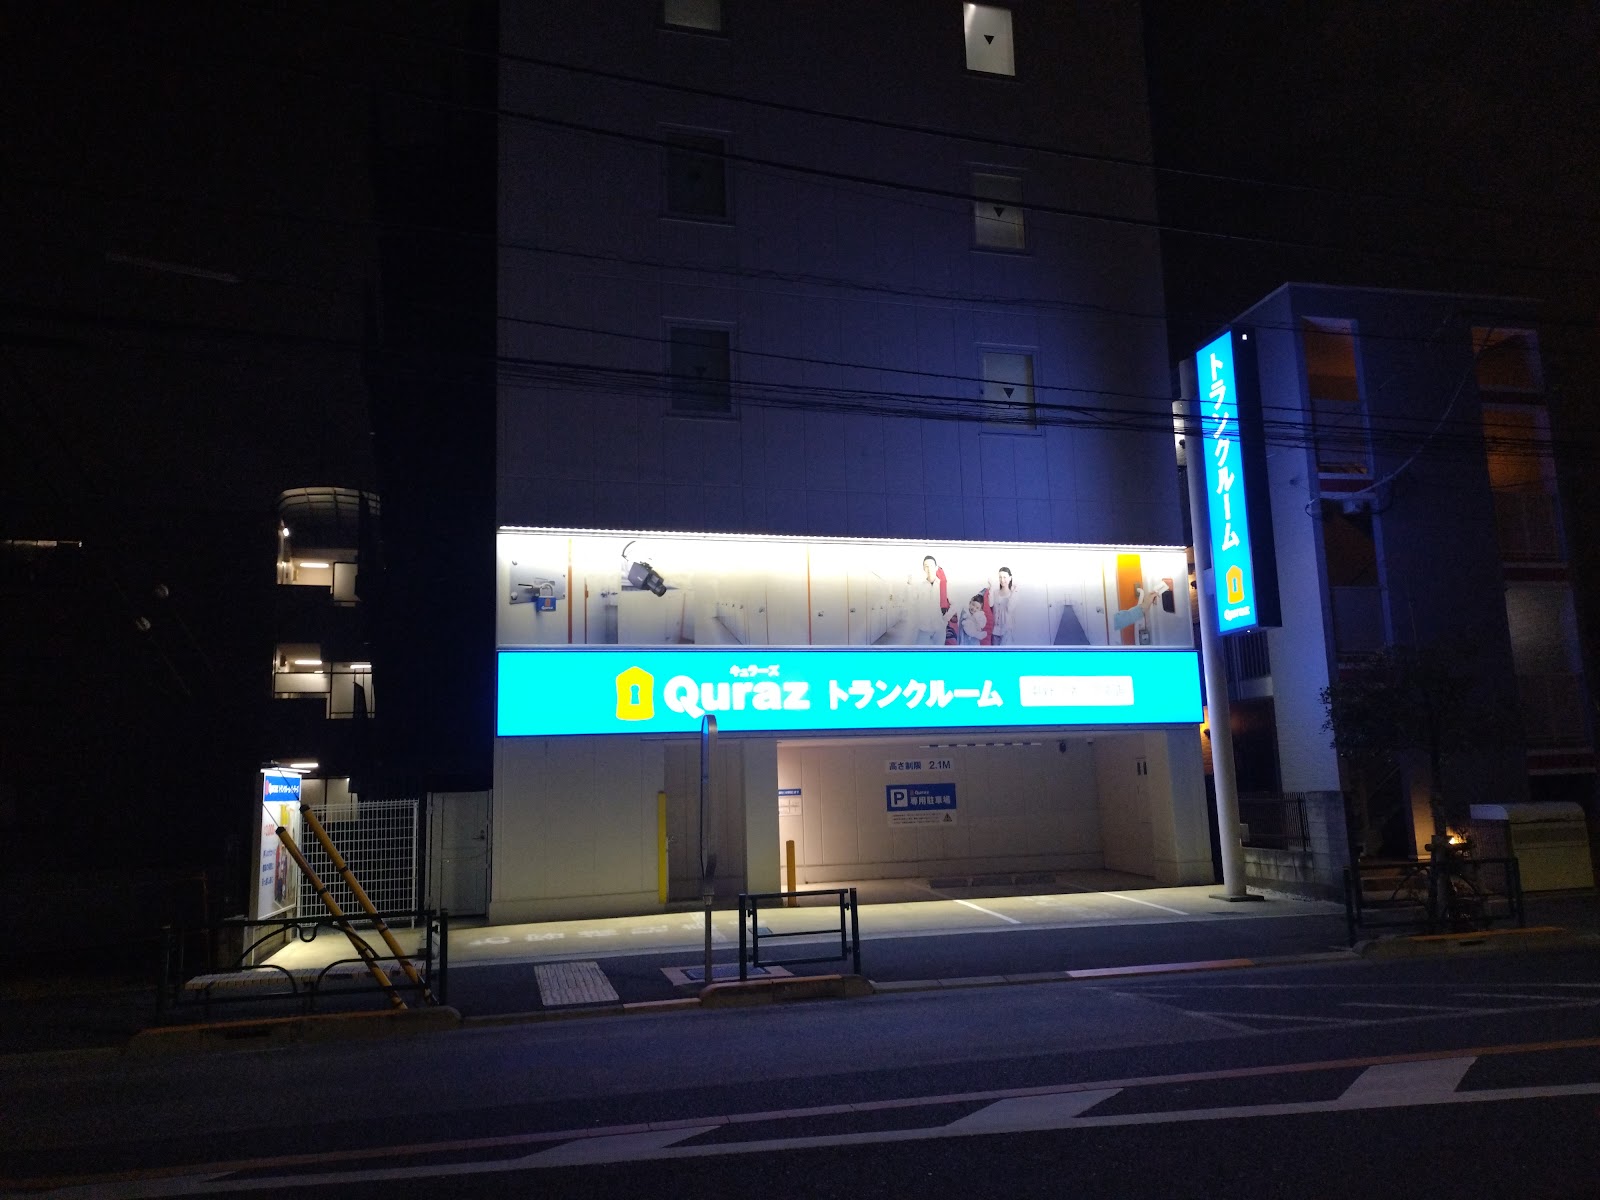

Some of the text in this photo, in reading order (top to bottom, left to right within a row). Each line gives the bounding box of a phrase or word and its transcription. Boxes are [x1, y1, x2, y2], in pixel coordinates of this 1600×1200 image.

[1209, 353, 1240, 552] トランクルーム
[663, 675, 1004, 719] Quraz トランクルーム
[889, 760, 951, 771] 高さ制限 2.1M
[893, 791, 905, 805] P
[910, 795, 951, 806] 専用駐車場
